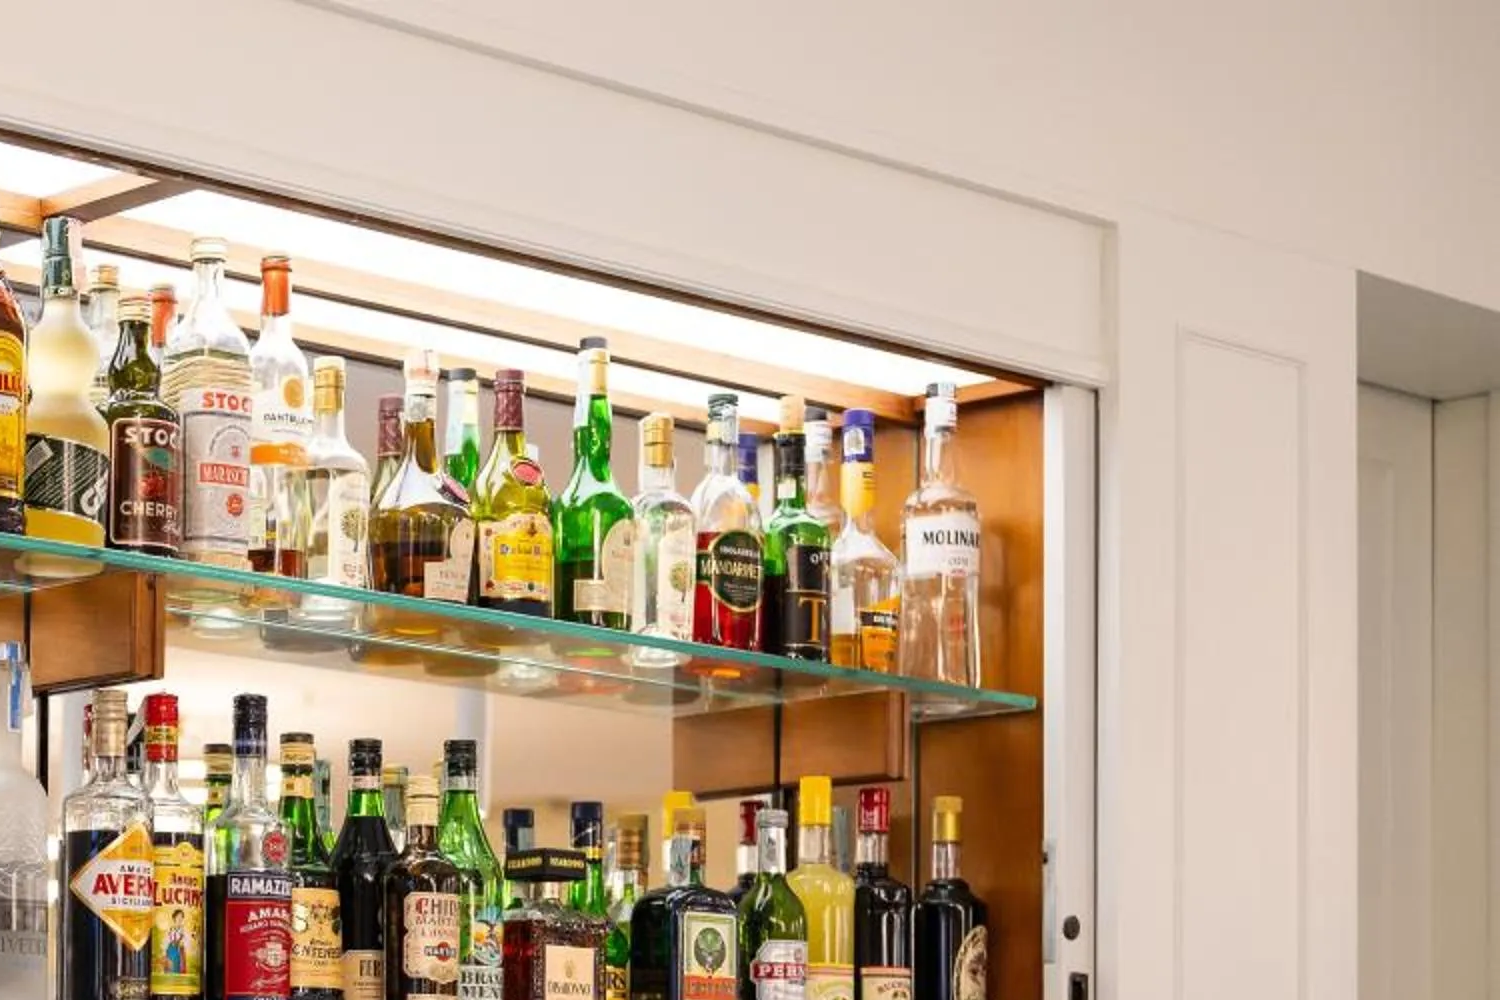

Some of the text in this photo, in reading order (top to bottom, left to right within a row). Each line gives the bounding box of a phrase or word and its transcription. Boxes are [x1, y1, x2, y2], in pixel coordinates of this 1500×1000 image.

[202, 391, 253, 413] STOC
[124, 426, 182, 449] STOC
[91, 873, 154, 895] AVERN
[757, 964, 805, 978] PERN
